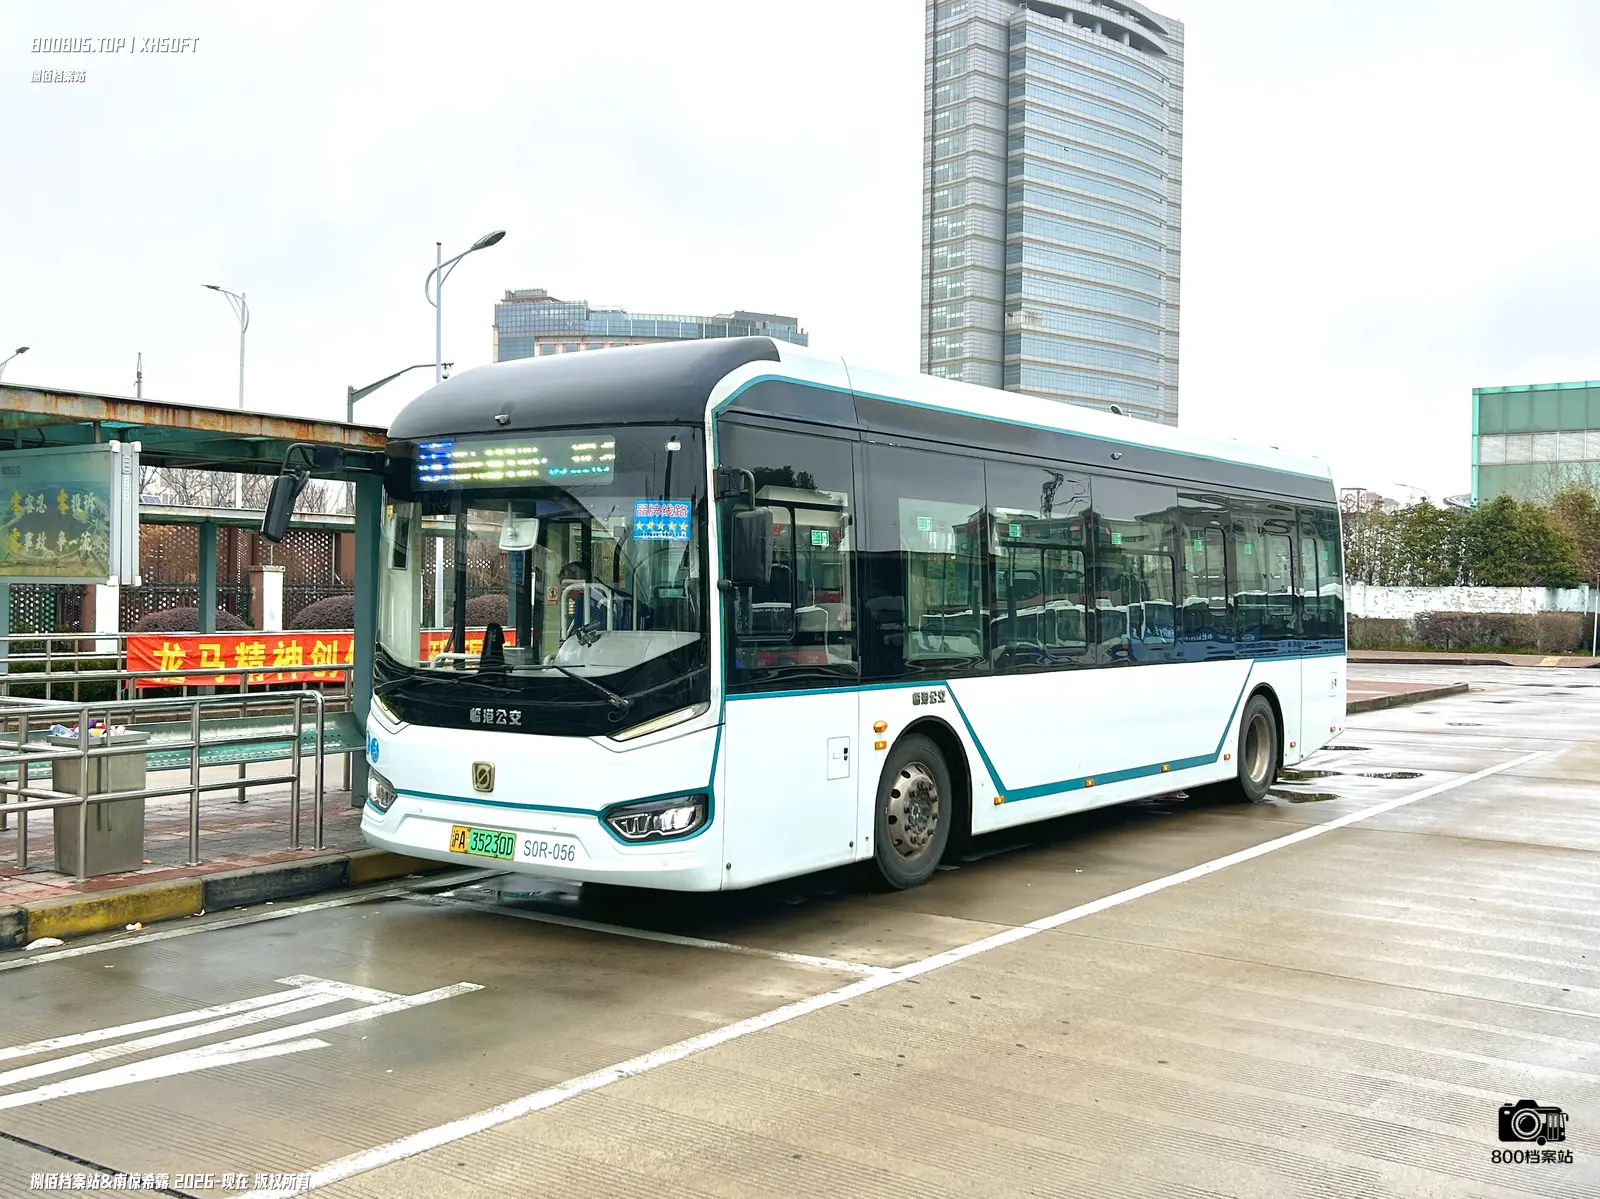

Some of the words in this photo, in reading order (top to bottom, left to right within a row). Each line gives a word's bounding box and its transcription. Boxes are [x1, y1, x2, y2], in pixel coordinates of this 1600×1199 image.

[636, 503, 688, 518] 品牌线路
[152, 639, 354, 683] 龙马精神创
[469, 707, 522, 726] 临港公交
